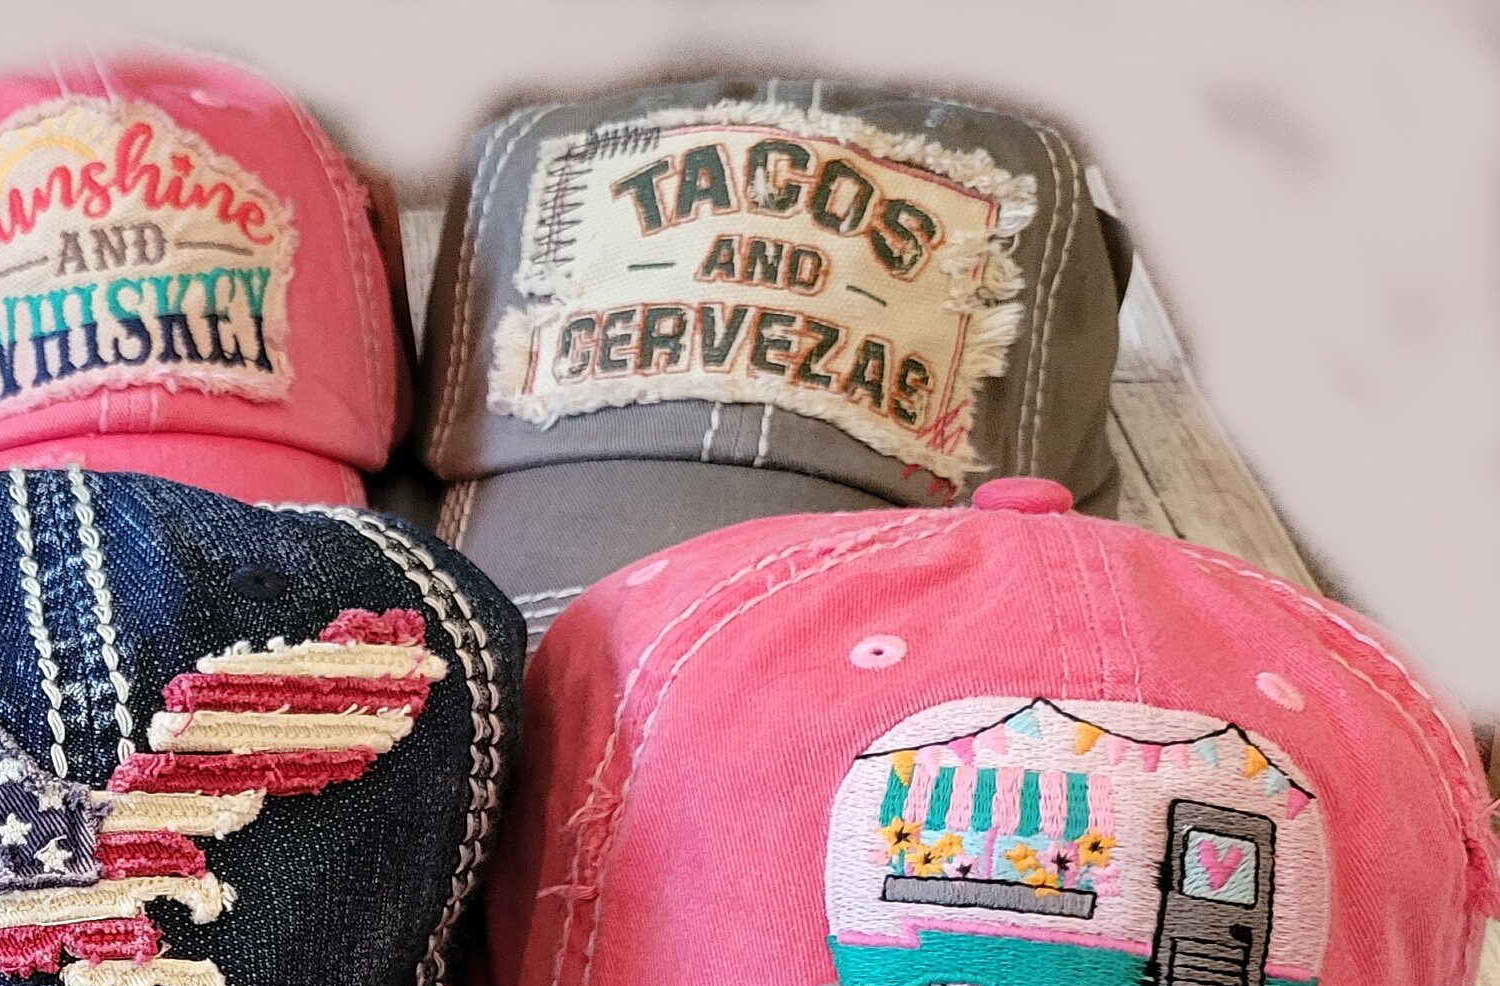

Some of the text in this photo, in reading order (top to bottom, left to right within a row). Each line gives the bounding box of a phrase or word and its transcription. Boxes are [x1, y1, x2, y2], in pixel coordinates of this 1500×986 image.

[54, 220, 168, 277] AND
[611, 136, 944, 284] TACOS
[695, 233, 830, 297] AND
[553, 301, 938, 433] CERVEZAS
